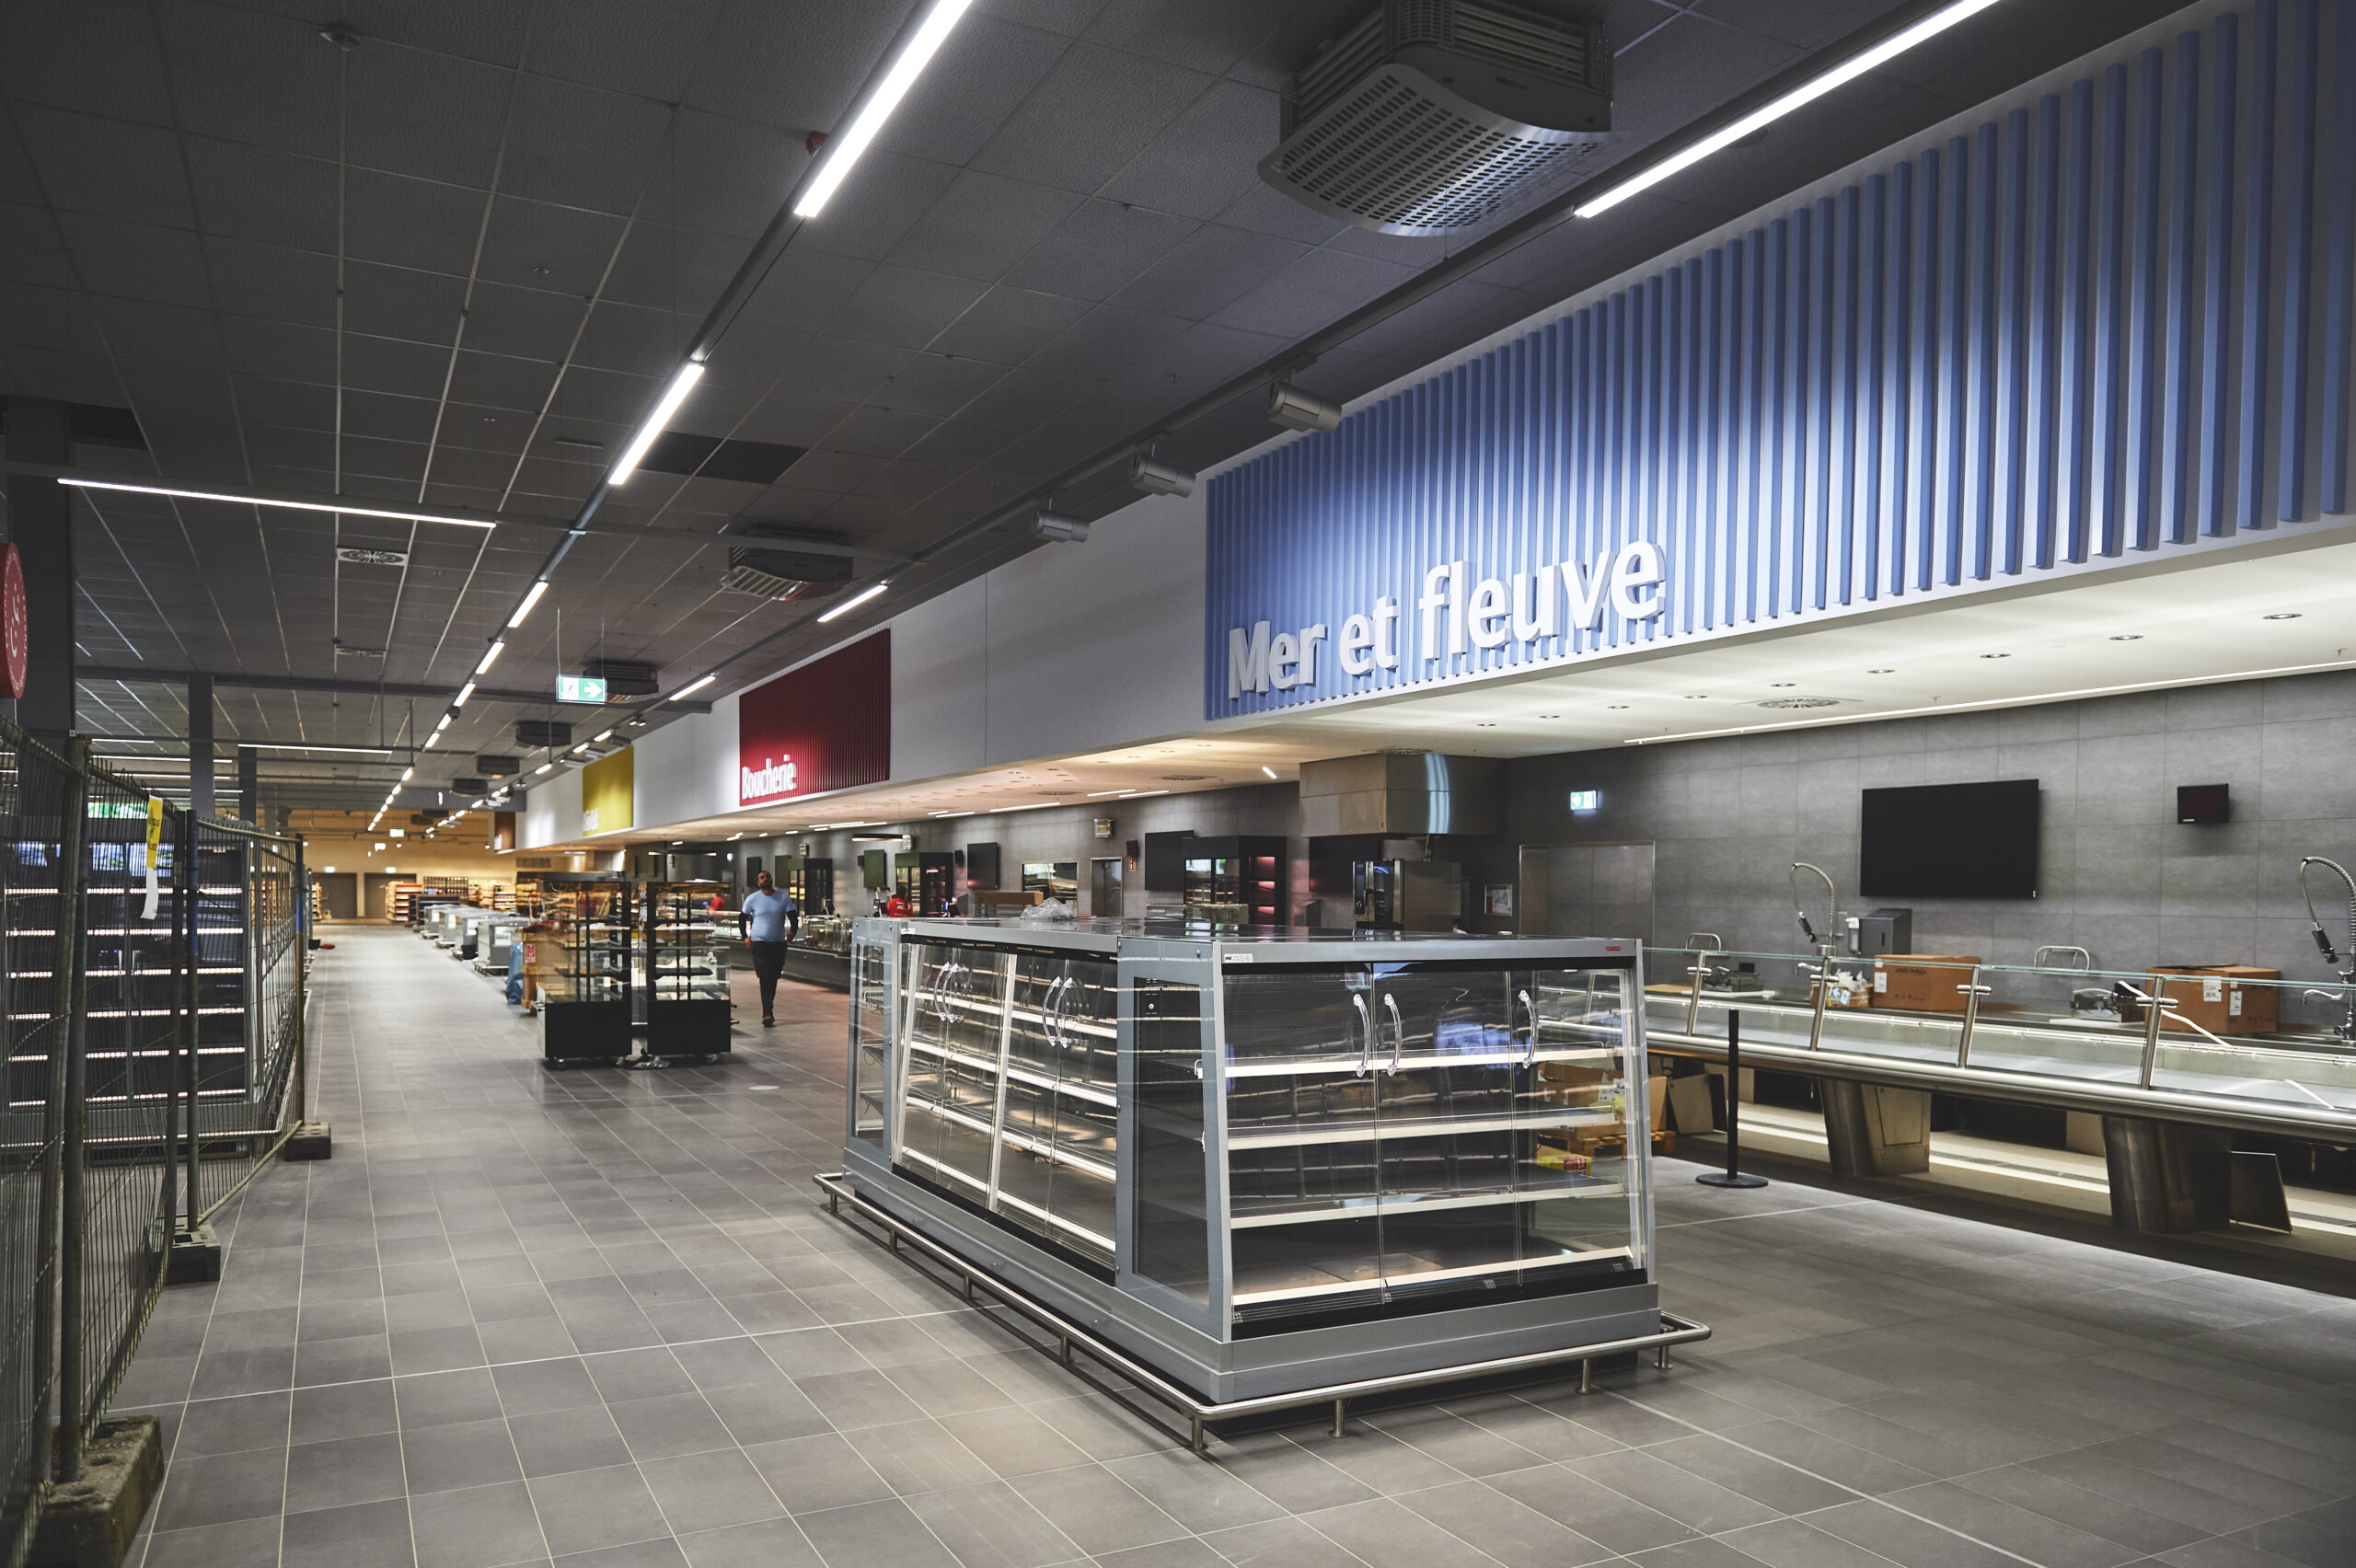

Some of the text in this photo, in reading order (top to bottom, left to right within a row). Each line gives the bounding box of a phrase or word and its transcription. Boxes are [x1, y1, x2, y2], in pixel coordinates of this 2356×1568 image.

[1229, 540, 1667, 699] Mer et fleuve
[742, 754, 797, 800] Boucherie
